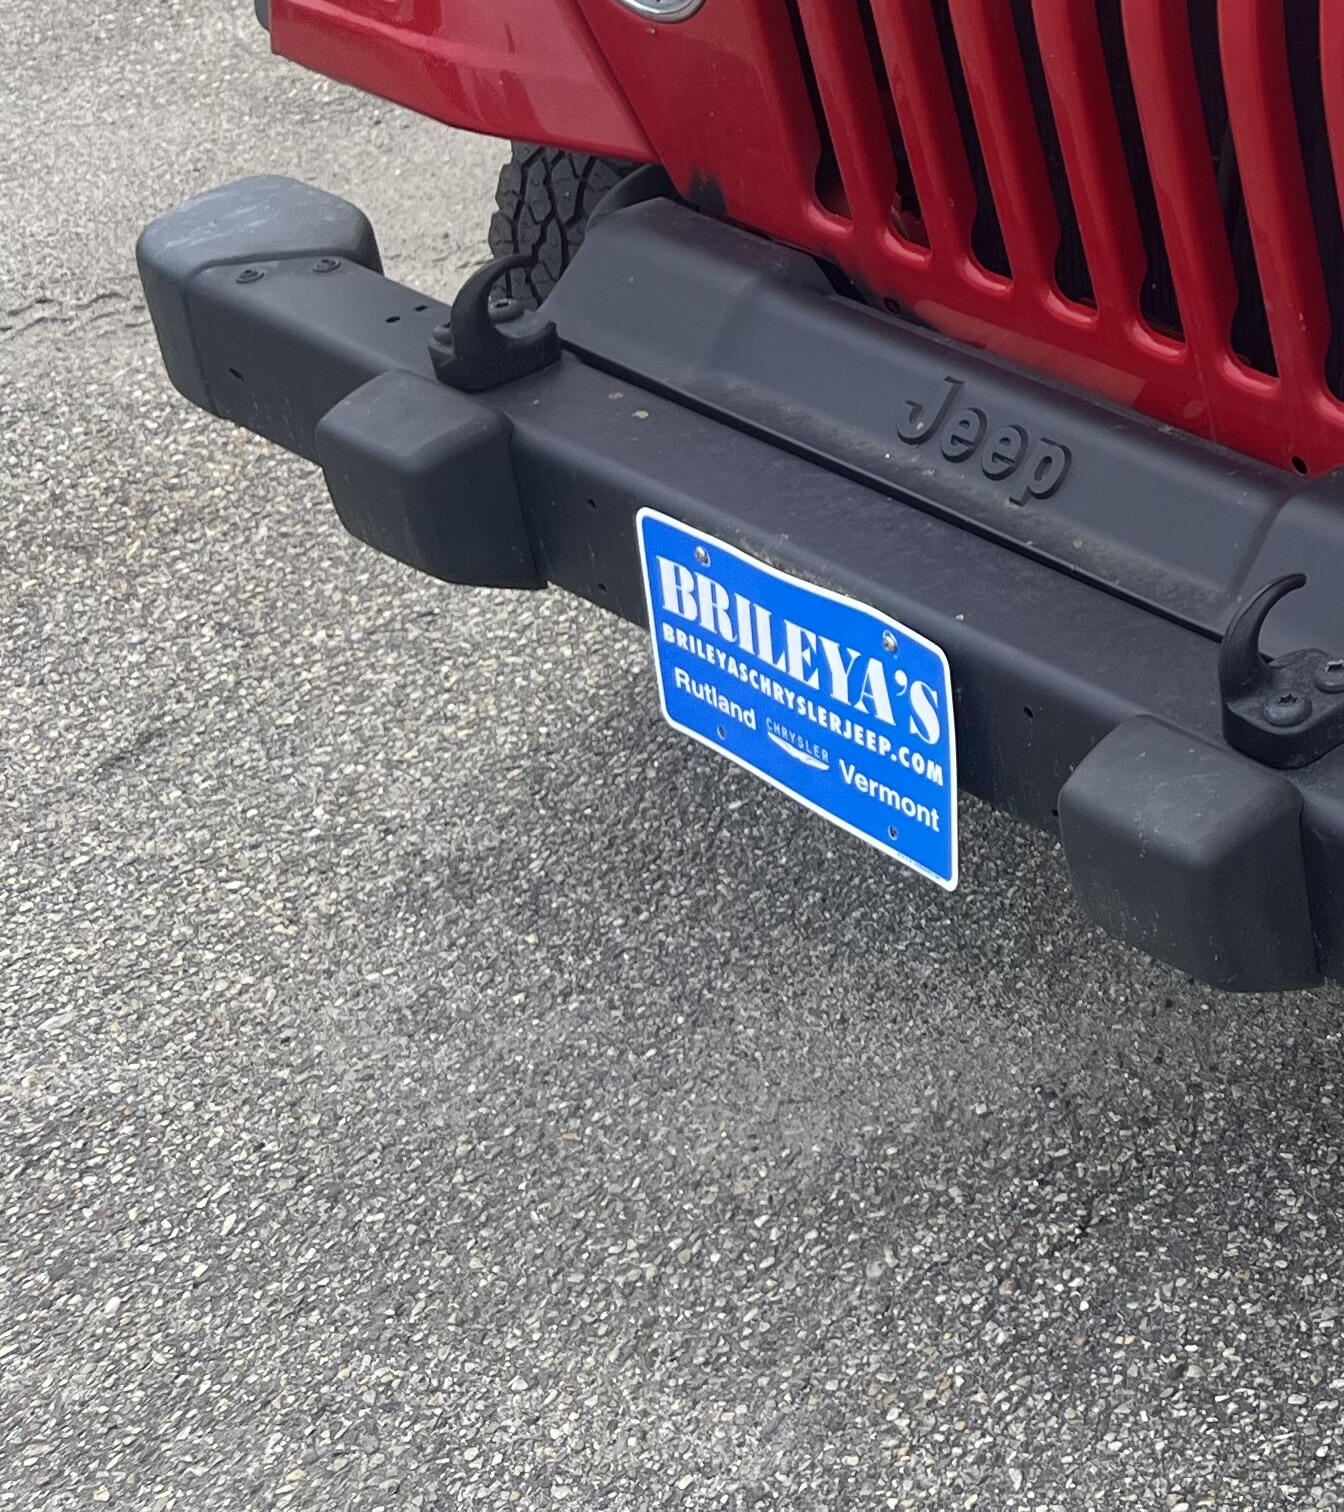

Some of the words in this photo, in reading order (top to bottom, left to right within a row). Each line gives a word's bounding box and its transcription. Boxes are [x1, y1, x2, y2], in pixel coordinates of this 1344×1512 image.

[896, 376, 1073, 508] Jeep
[656, 555, 941, 746] BRILEYA'S
[674, 666, 757, 731] Rutland
[662, 622, 945, 787] BRILEYASCHRYSLERJEEP.COM
[766, 717, 829, 765] CHRYSLER
[839, 758, 940, 833] Vermont
